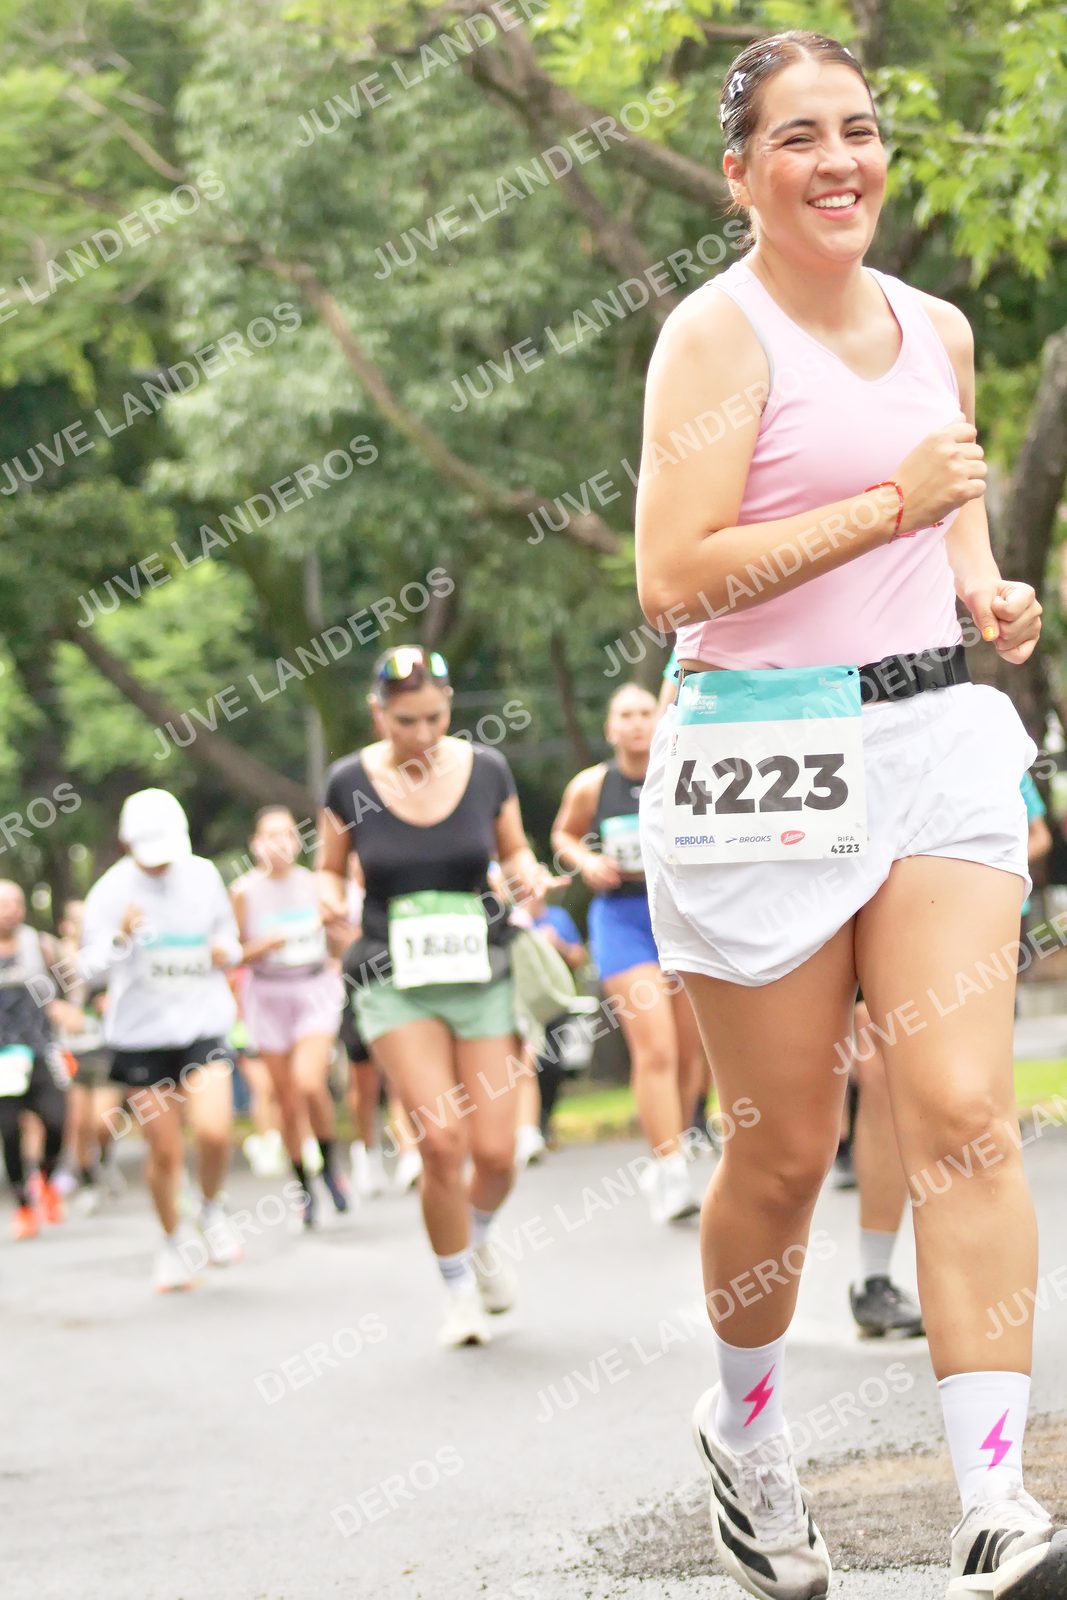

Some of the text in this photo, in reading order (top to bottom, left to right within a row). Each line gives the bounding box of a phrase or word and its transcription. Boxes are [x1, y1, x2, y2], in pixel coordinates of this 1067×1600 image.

[674, 753, 849, 815] 4223
[675, 835, 715, 846] PERDURA
[739, 835, 772, 844] BROOKS
[830, 844, 860, 854] 4223
